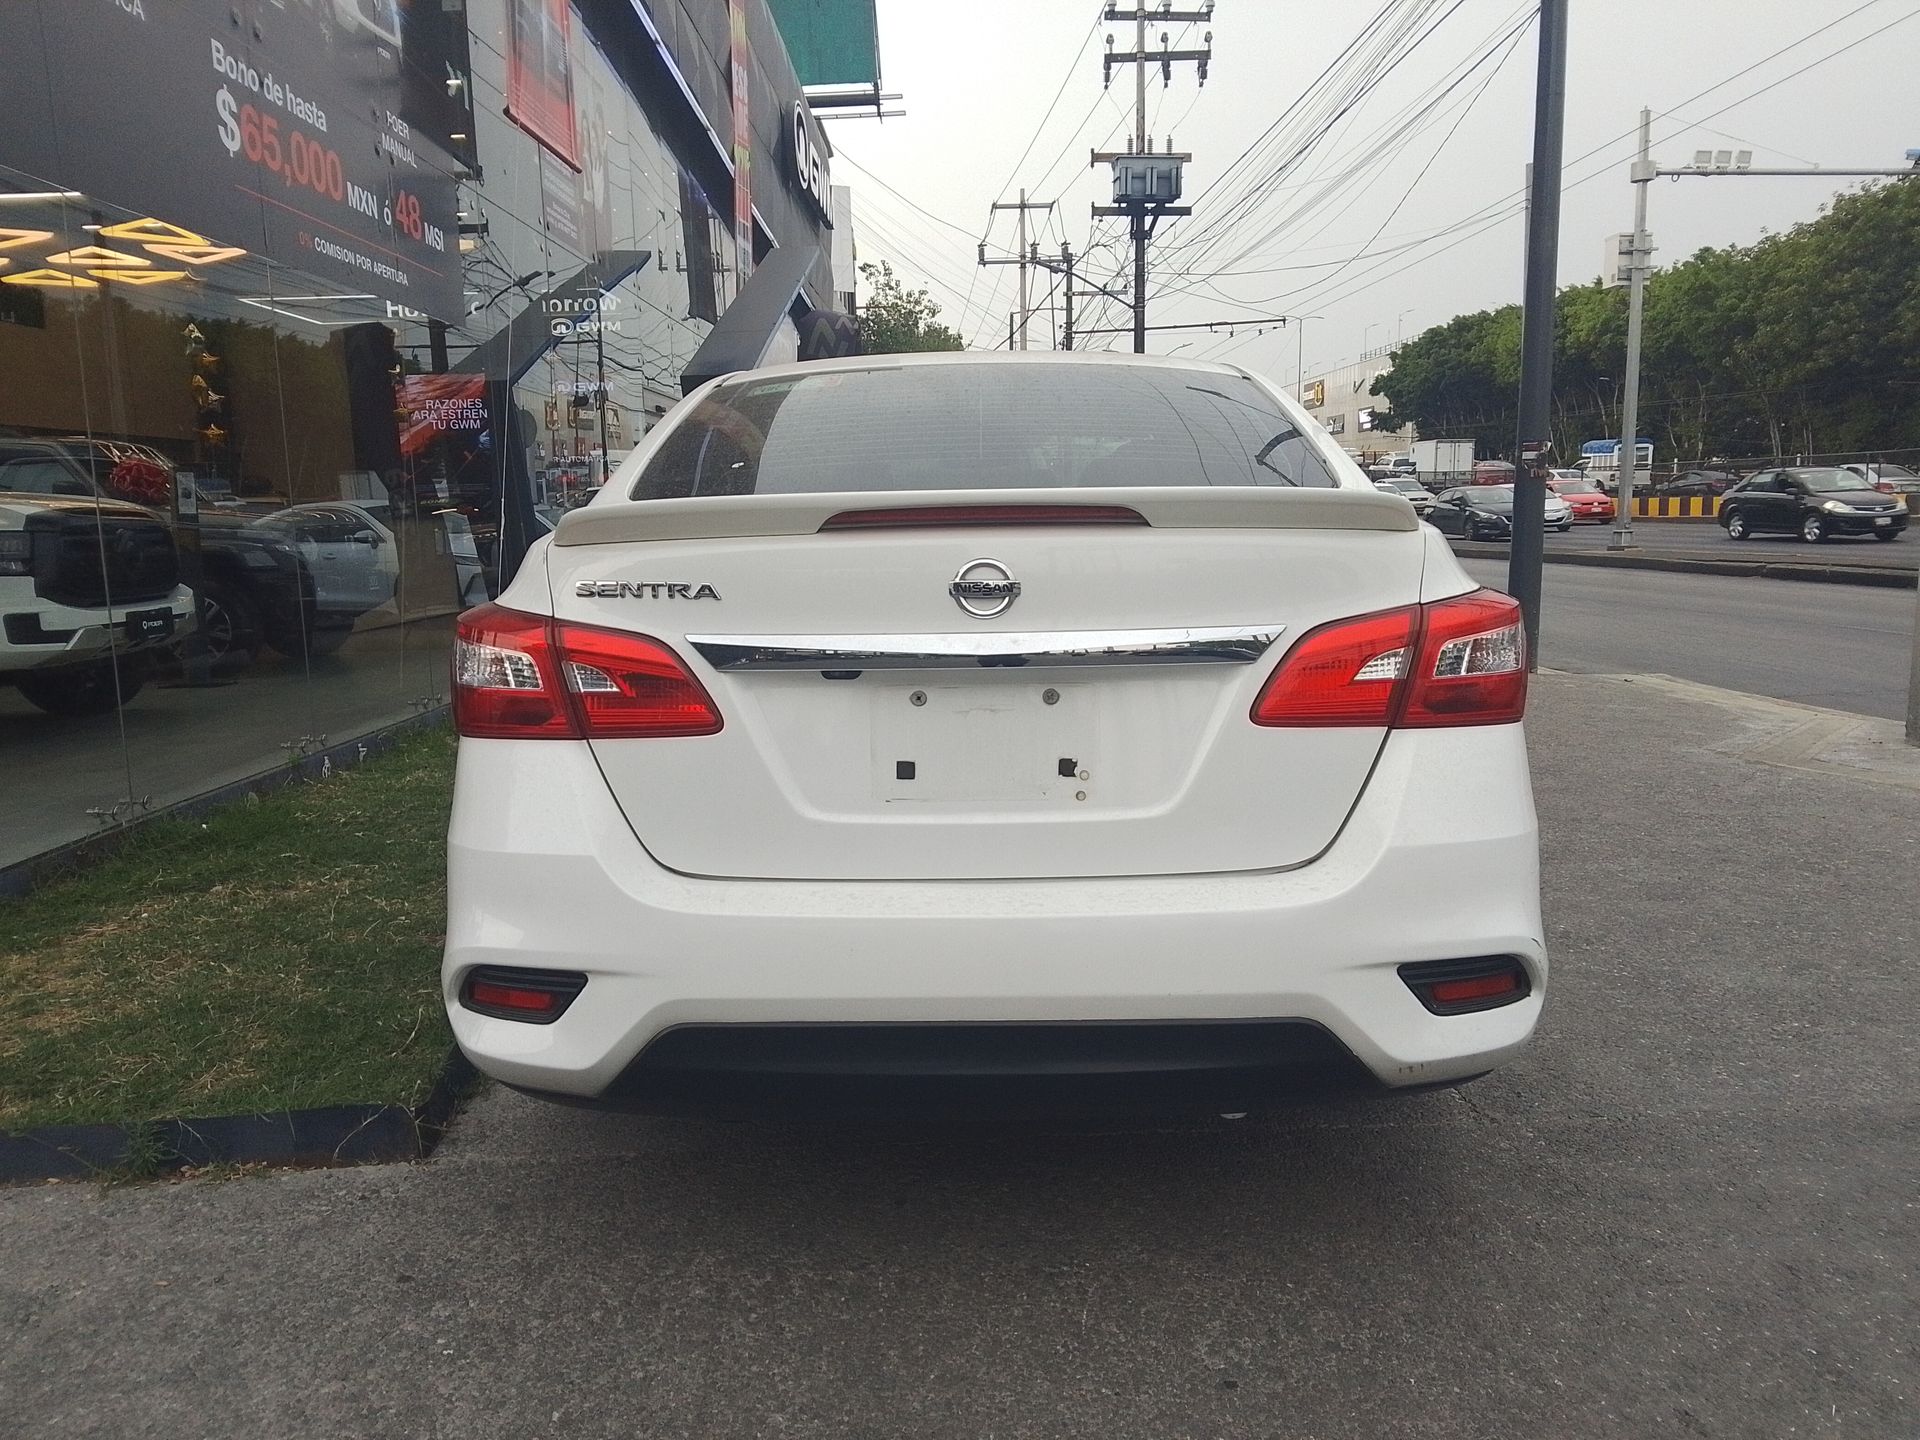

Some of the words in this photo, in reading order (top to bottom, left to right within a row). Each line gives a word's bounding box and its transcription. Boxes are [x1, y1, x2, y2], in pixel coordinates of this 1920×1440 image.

[211, 38, 259, 92] Bono
[263, 72, 283, 106] de
[285, 84, 327, 132] hasta
[381, 132, 417, 169] MANUAL
[216, 84, 343, 201] $65,000
[346, 181, 378, 219] MXN
[383, 200, 392, 226] ó
[395, 189, 422, 240] 48
[424, 222, 444, 252] MSI
[314, 236, 355, 265] COMISION
[355, 254, 373, 271] POR
[373, 262, 409, 286] APERTURA
[576, 320, 621, 333] GWM
[573, 381, 614, 393] GWM
[425, 399, 483, 410] RAZONES
[431, 420, 446, 430] TU
[450, 420, 481, 430] GWM
[575, 579, 722, 601] SENTRA
[956, 583, 1014, 593] NISSAN
